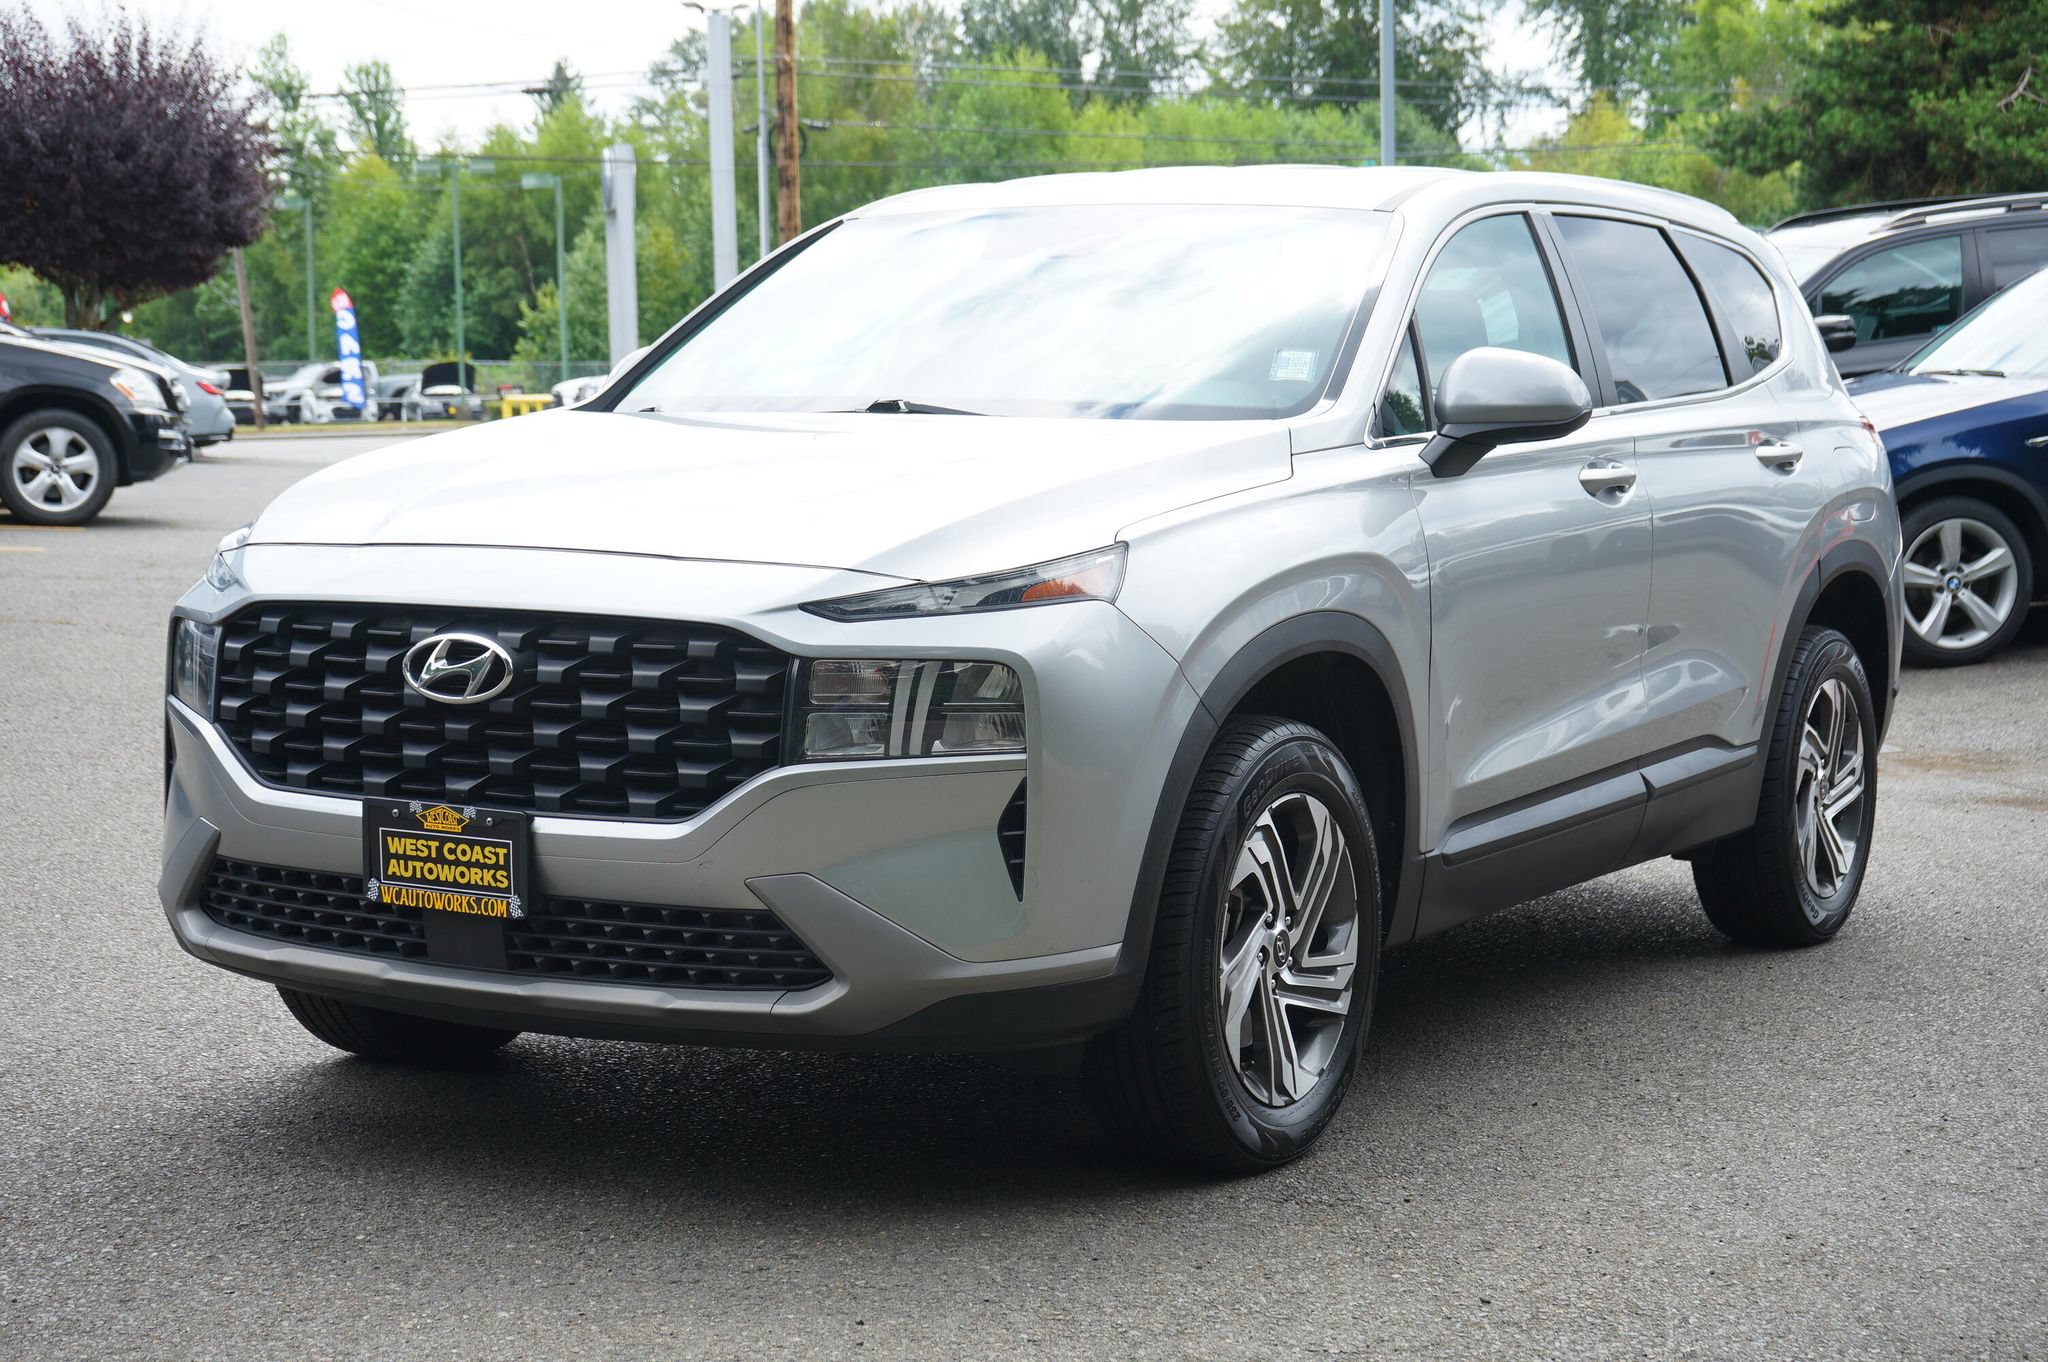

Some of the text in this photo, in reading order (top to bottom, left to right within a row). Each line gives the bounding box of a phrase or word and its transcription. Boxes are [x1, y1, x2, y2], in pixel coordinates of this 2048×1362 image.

[387, 836, 508, 865] WEST COAST
[387, 859, 509, 888] AUTOWORKS
[380, 885, 508, 918] WCAUTOWORKS.COM
